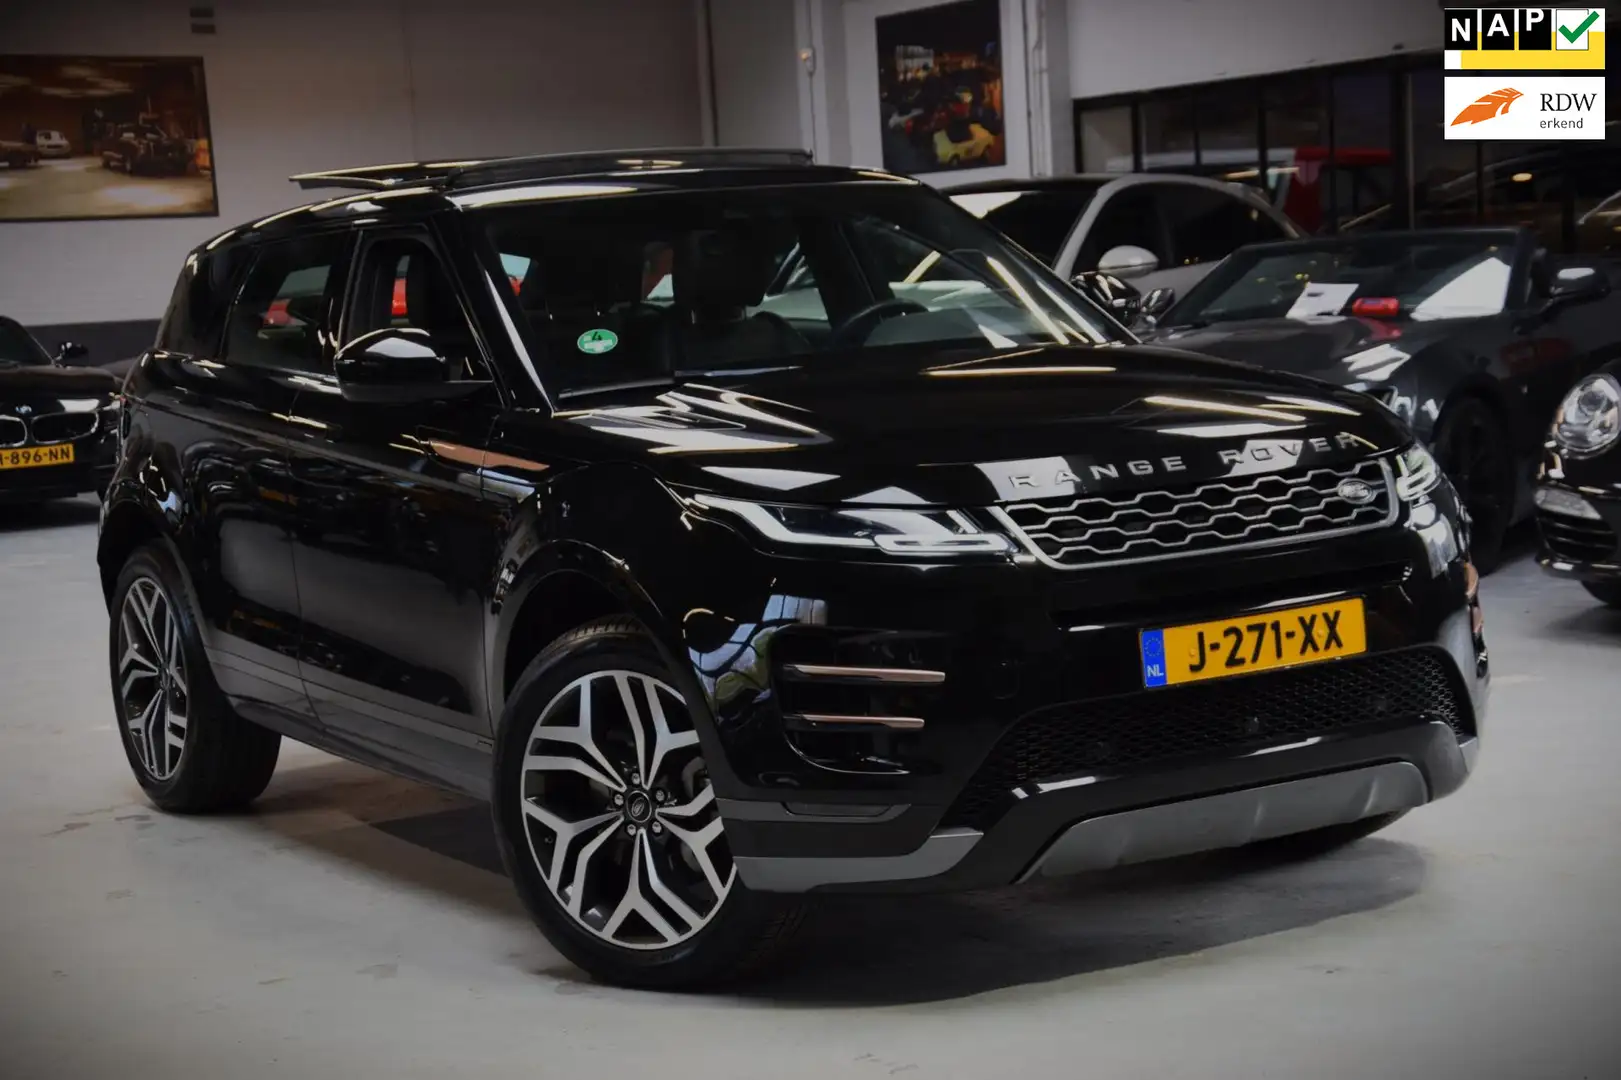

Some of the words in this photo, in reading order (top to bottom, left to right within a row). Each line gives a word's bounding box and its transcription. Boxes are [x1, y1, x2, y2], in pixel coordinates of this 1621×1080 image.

[0, 447, 71, 466] -896-NN
[1007, 455, 1187, 490] RANGE
[1218, 431, 1362, 466] ROVER
[1188, 610, 1343, 674] J-271-XX
[1147, 664, 1165, 678] NL
